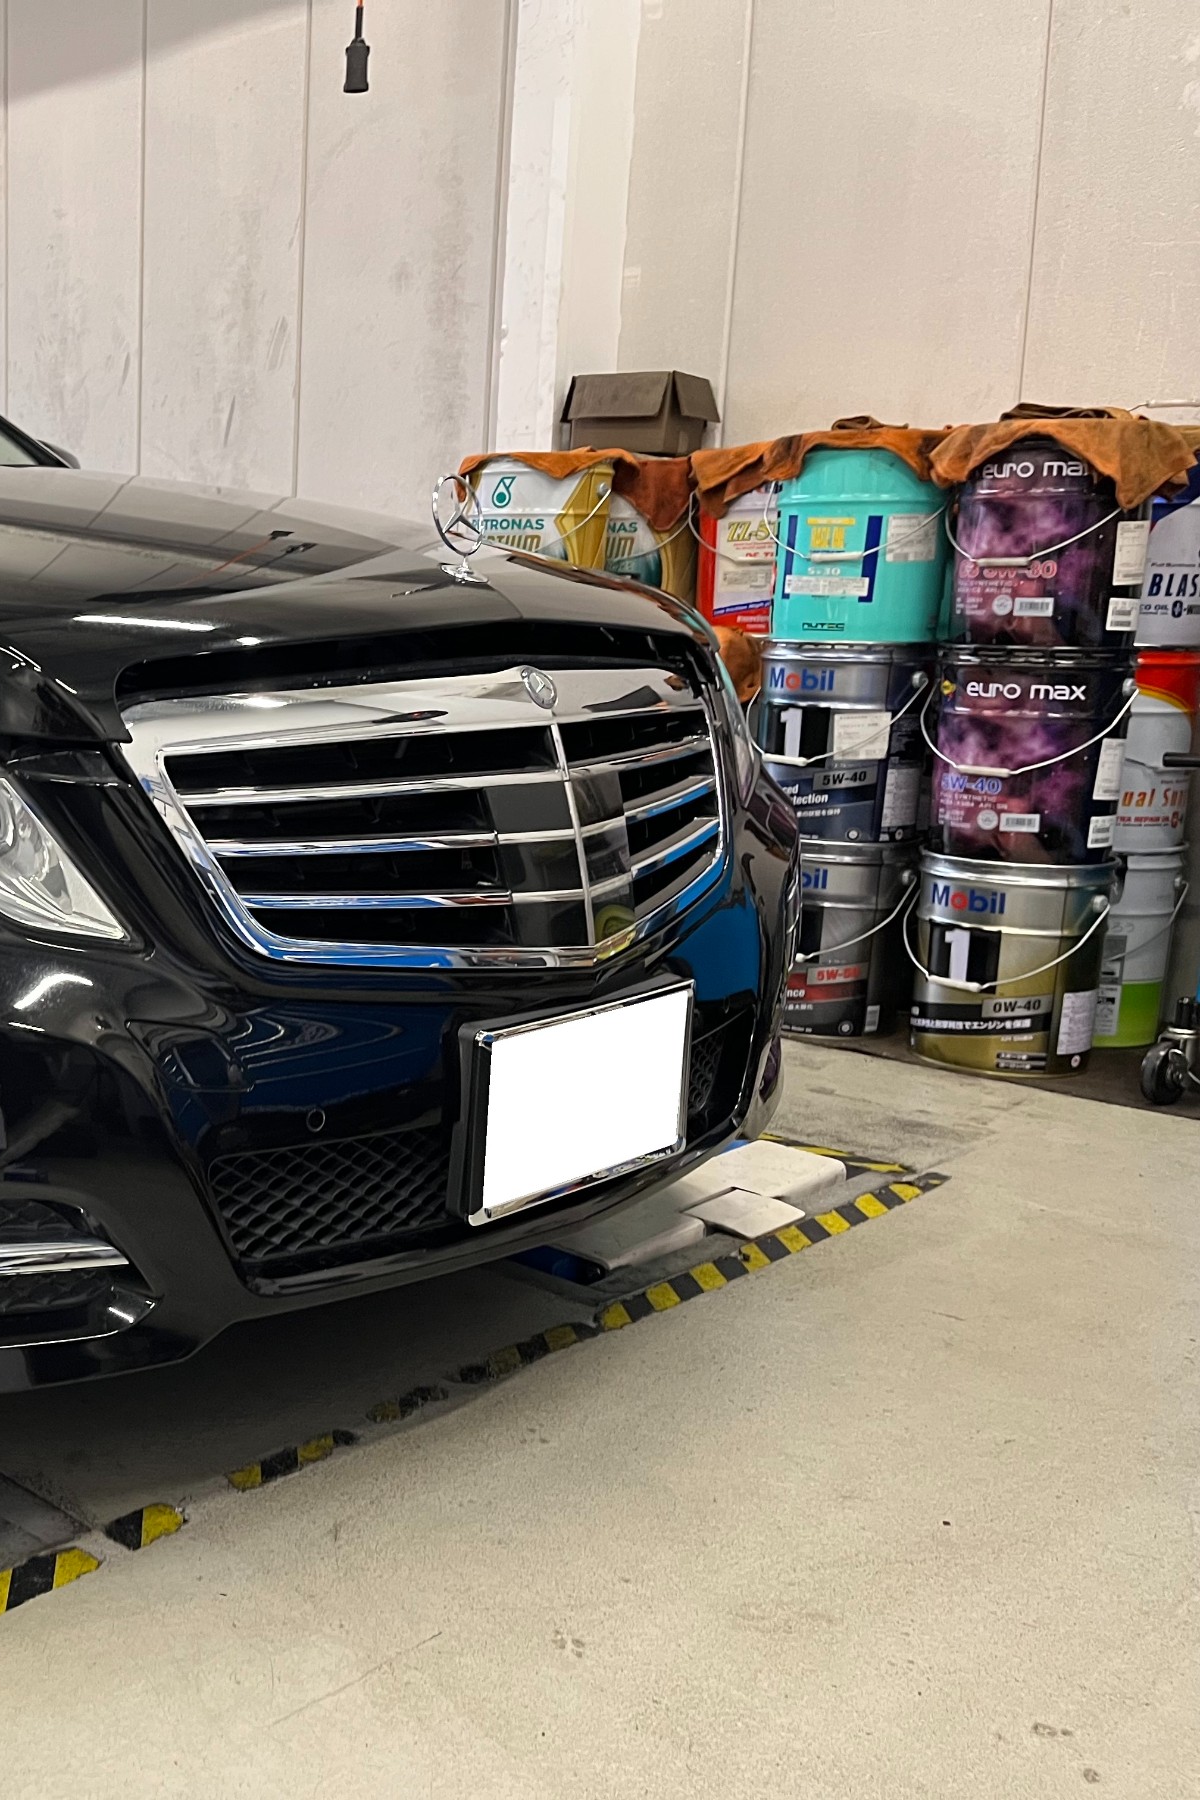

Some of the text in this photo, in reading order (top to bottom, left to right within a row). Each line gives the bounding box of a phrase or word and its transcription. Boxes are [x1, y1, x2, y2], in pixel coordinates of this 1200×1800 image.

[982, 461, 1088, 479] euro ma
[769, 667, 835, 692] Mobil
[966, 681, 1087, 701] euro max
[780, 707, 803, 757] 1
[822, 771, 867, 786] 5W-40
[931, 882, 1006, 914] Mobil
[945, 929, 971, 983] 1
[993, 1000, 1042, 1014] 0W-40
